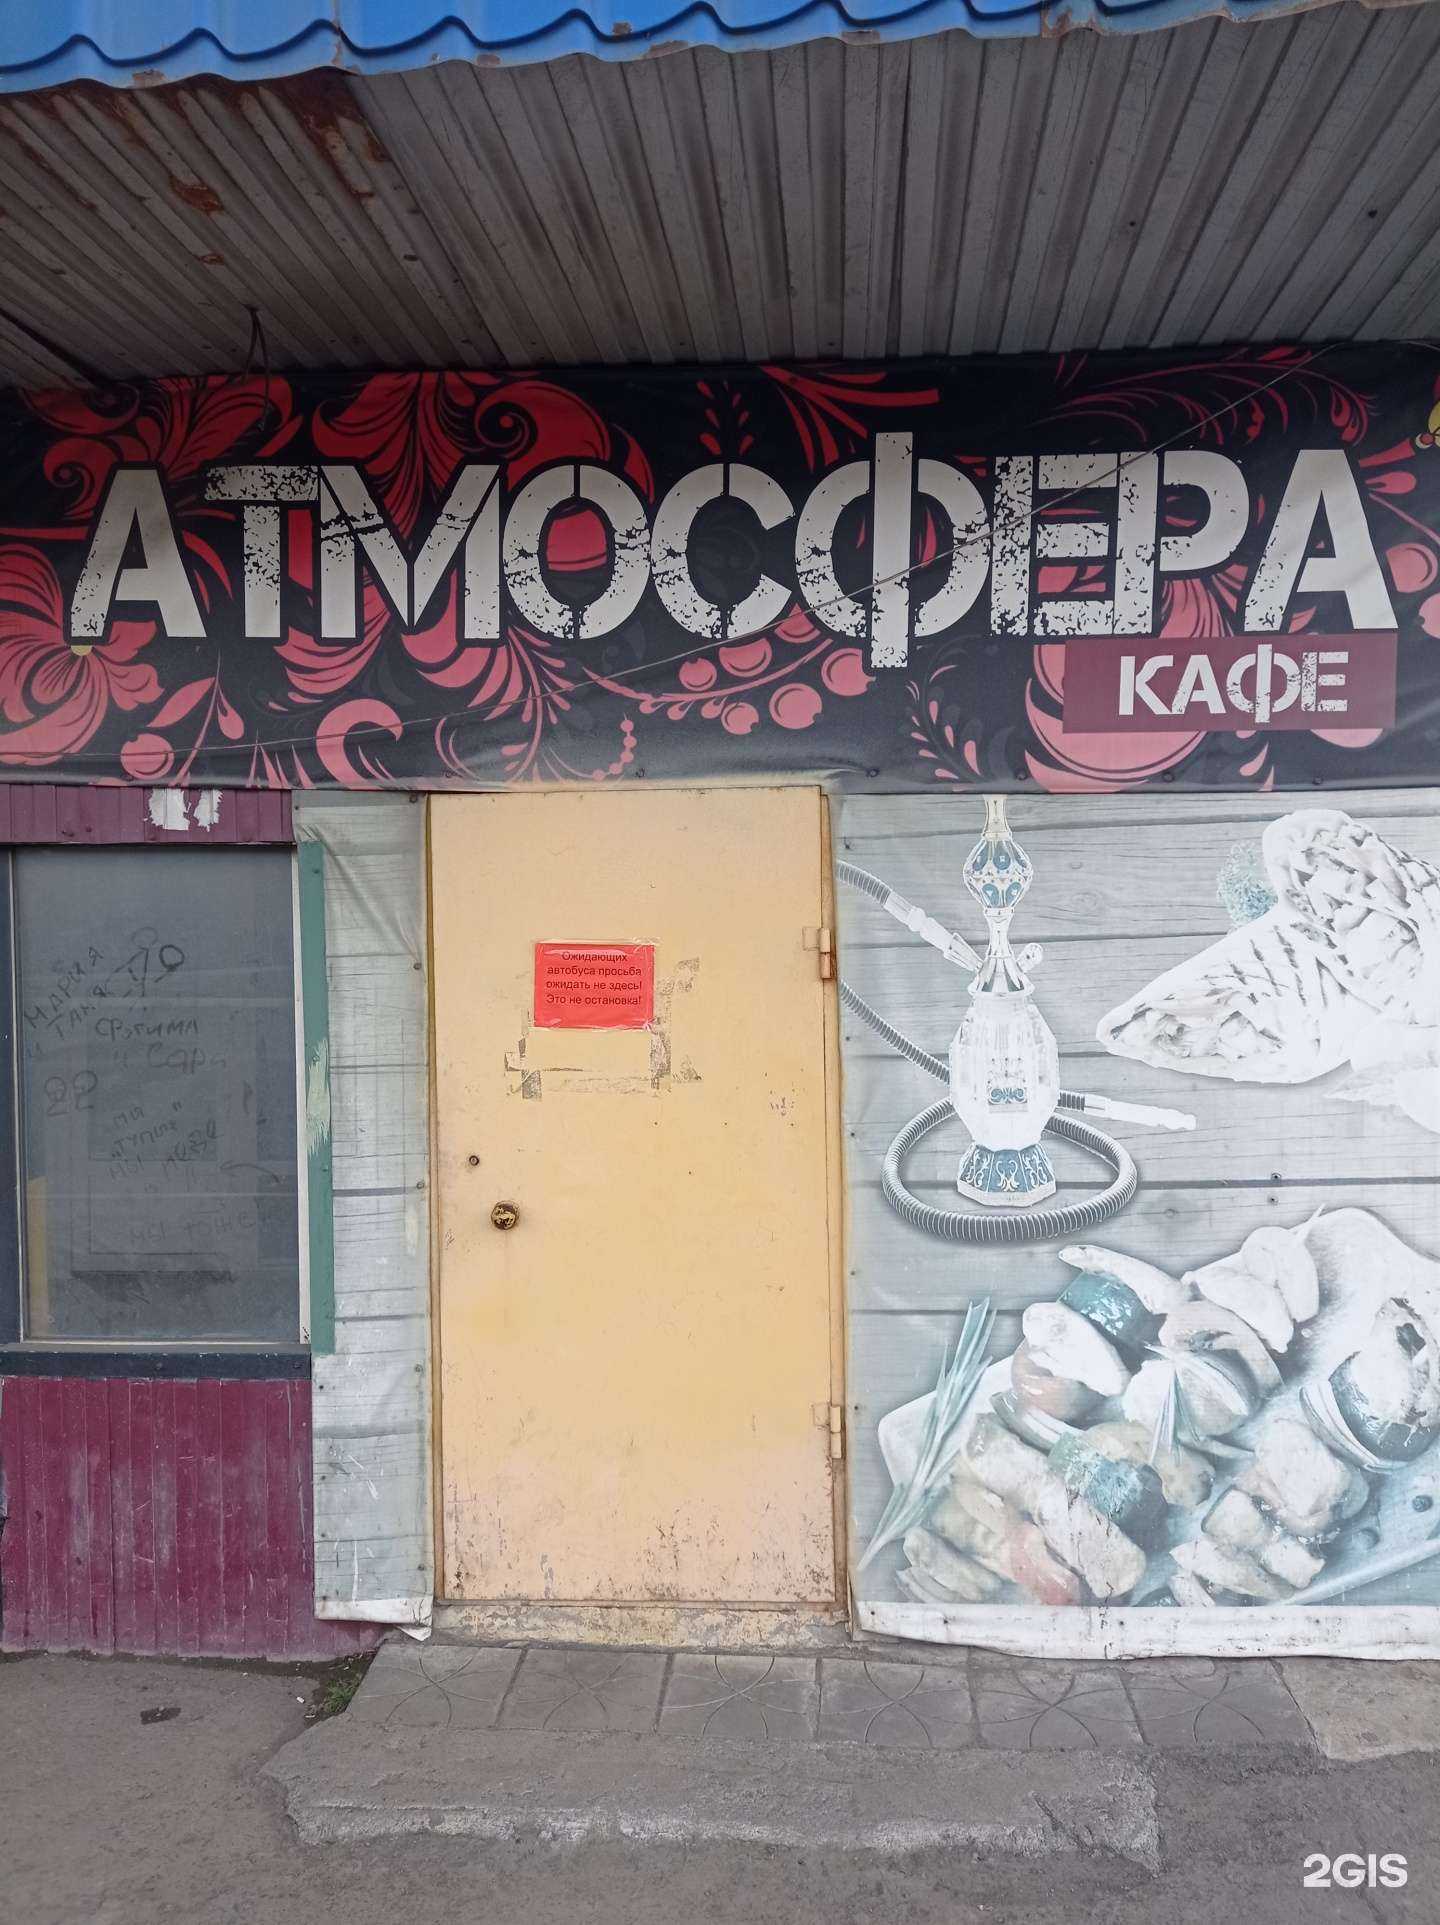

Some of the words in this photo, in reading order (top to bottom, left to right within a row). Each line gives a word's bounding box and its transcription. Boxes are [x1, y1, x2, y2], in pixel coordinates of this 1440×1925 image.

[71, 431, 1399, 668] АТМОСФЕРА
[1117, 643, 1349, 725] КАФЕ
[561, 951, 628, 964] Ожидающих
[546, 966, 596, 977] автобуса
[598, 967, 642, 978] просьба
[546, 980, 591, 991] ожидать
[593, 982, 607, 991] не
[609, 981, 643, 992] здесь!
[546, 994, 567, 1005] Это
[569, 996, 583, 1005] не
[584, 995, 642, 1006] остановка!
